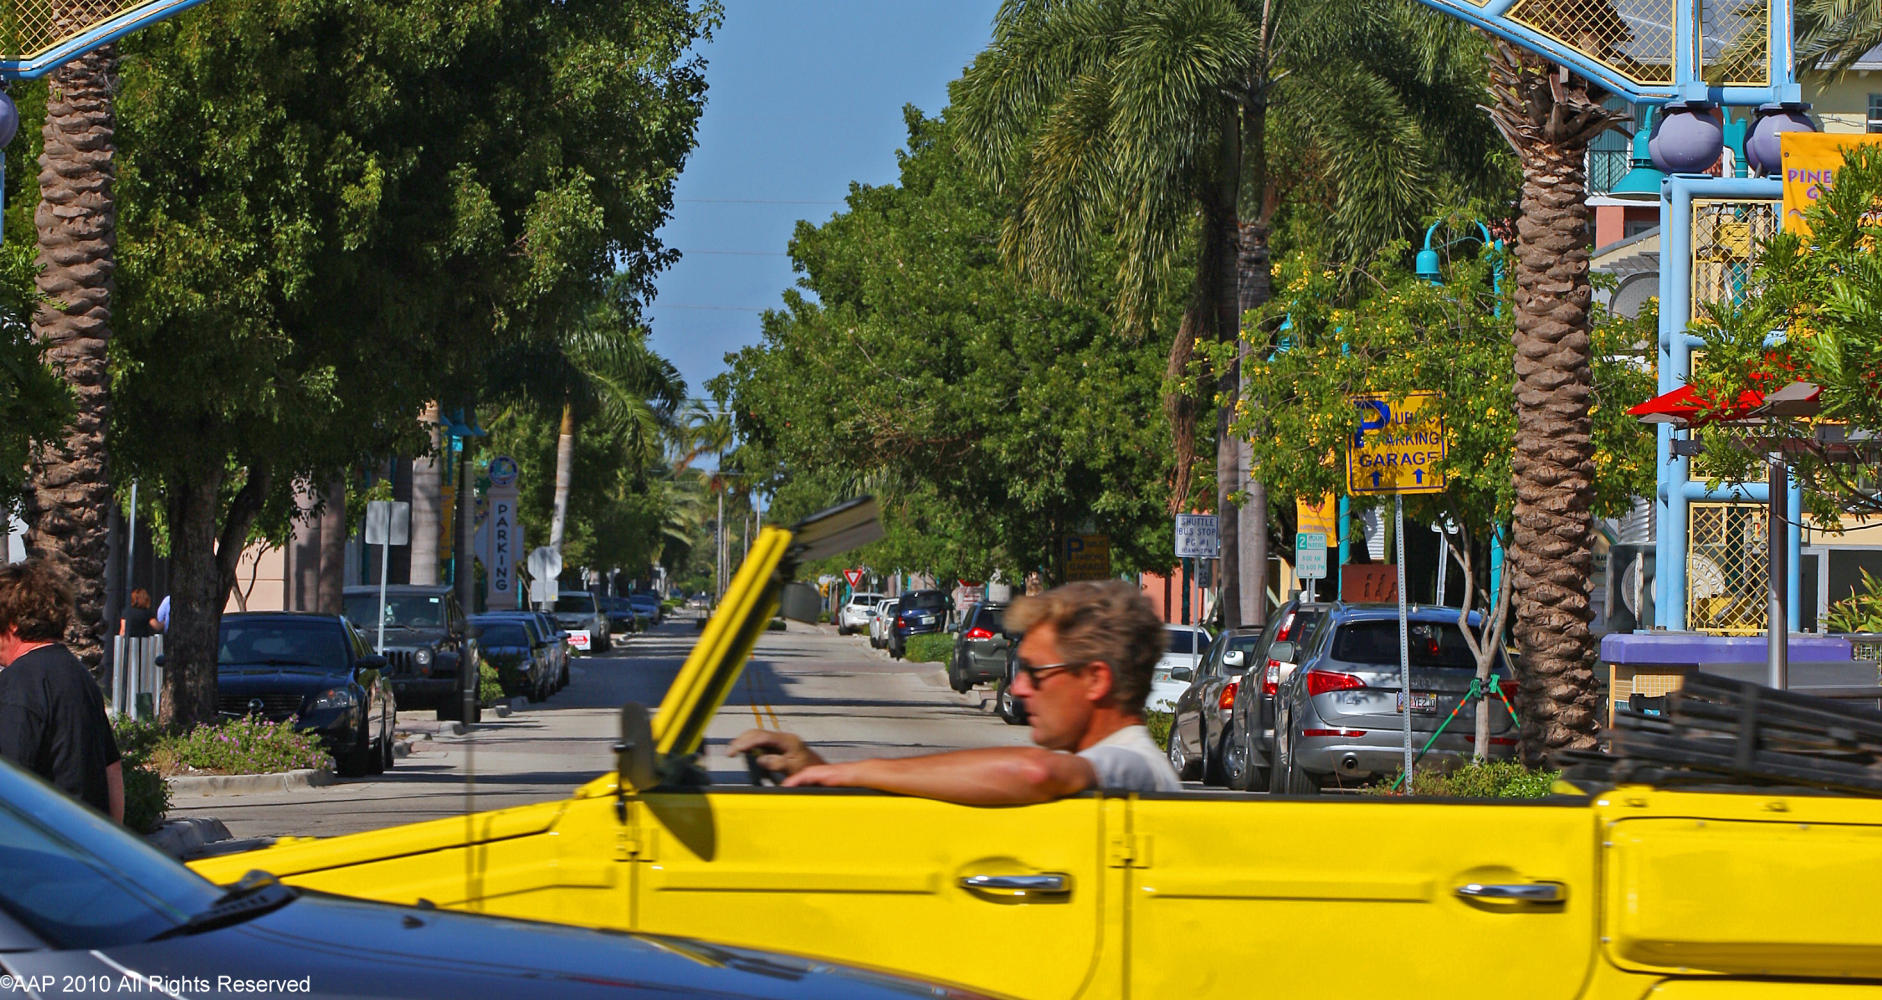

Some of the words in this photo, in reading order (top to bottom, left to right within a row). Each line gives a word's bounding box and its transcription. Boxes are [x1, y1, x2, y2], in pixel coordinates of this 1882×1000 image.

[1359, 451, 1441, 468] GARAGE
[1181, 517, 1215, 527] SHUTTLE
[1178, 527, 1194, 536] BUS
[1197, 527, 1216, 537] STOP
[495, 504, 508, 591] PARKING
[1299, 536, 1306, 548] 2
